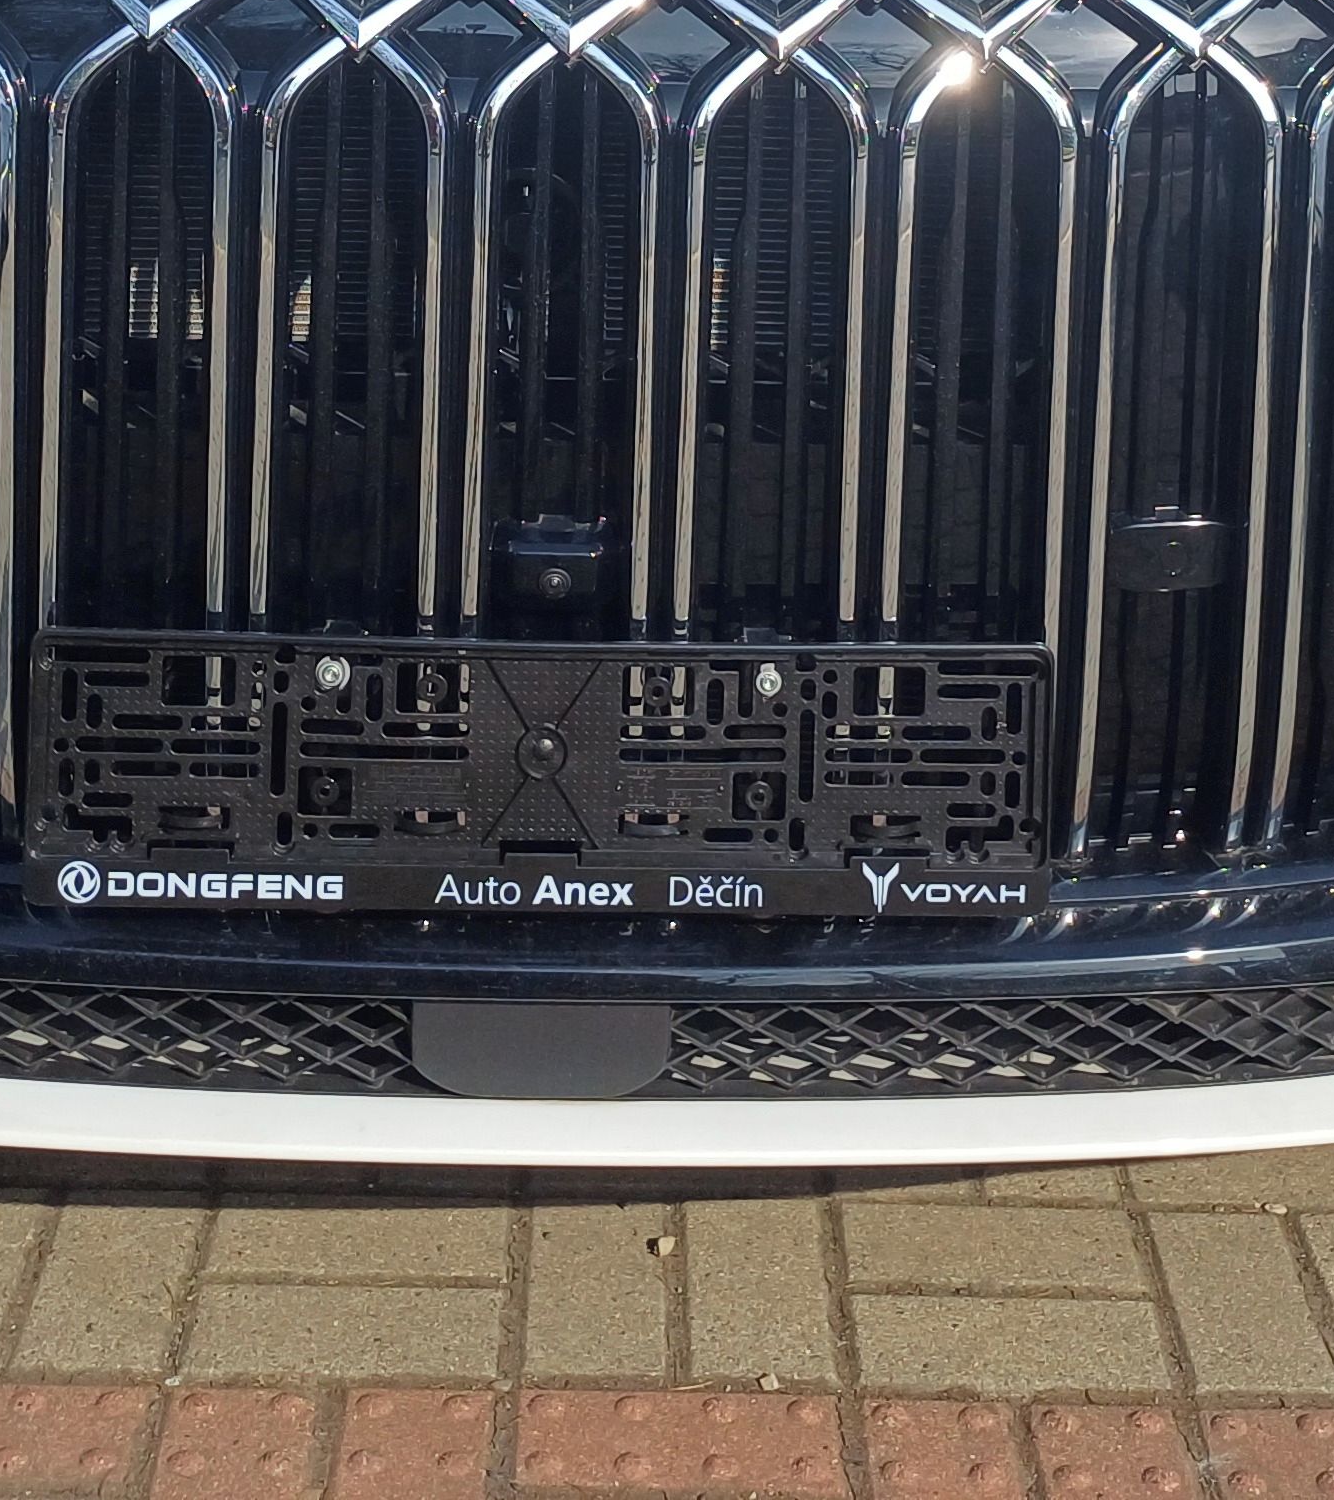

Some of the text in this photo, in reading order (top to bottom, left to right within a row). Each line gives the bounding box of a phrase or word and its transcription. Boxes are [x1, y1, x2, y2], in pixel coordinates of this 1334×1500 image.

[107, 871, 1027, 908] DONGFENG Auto Anex Děčín VOYAH
